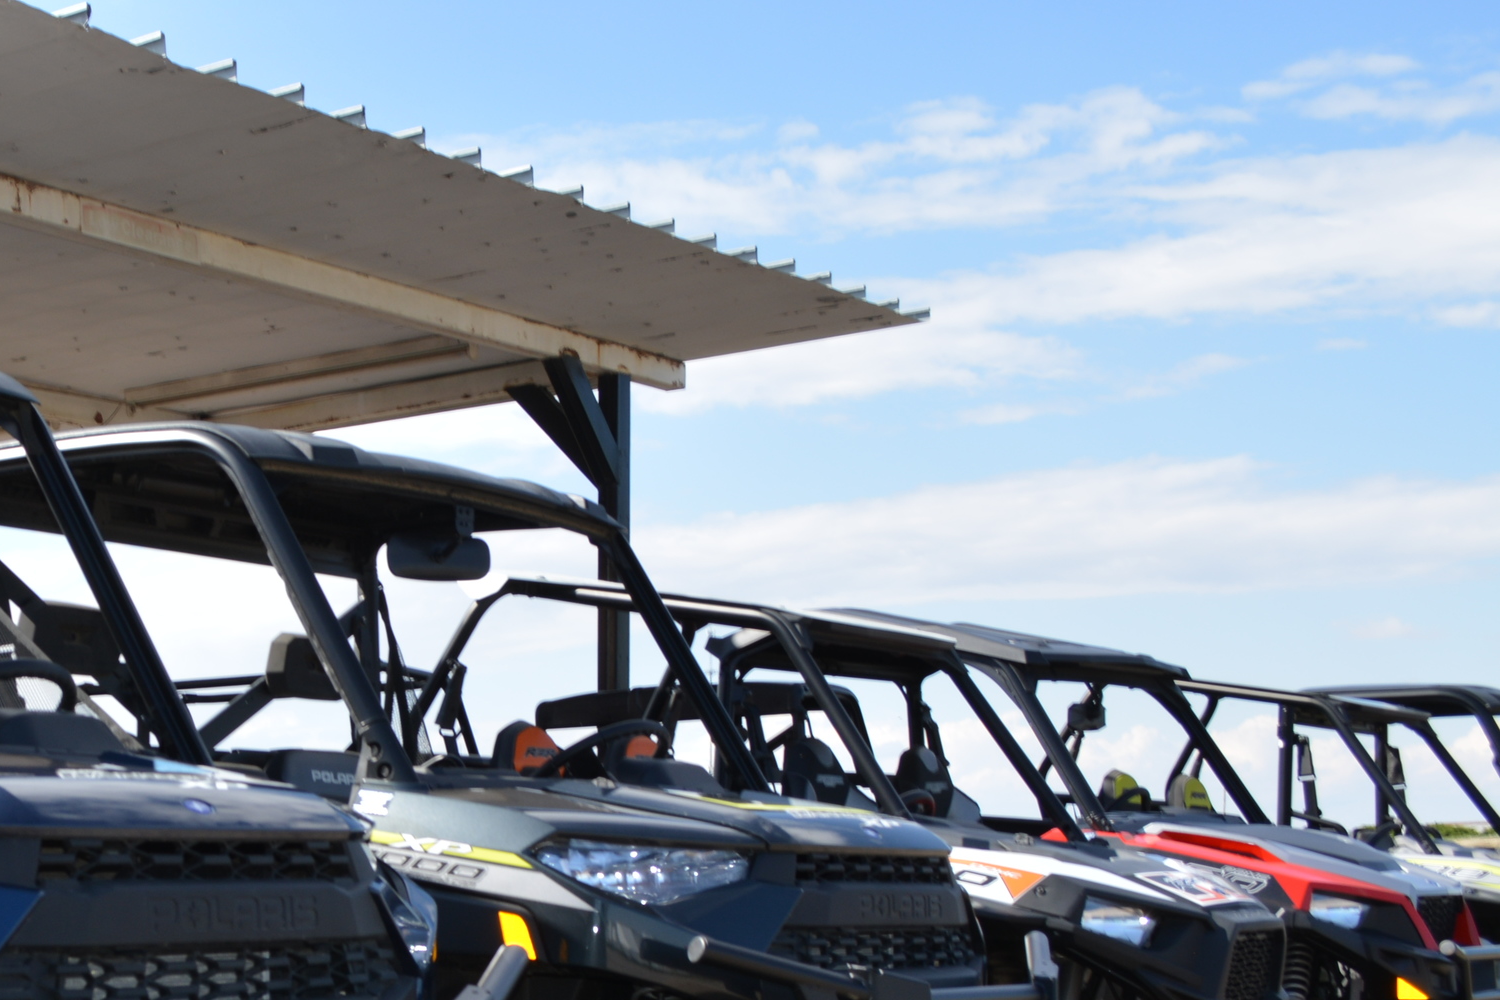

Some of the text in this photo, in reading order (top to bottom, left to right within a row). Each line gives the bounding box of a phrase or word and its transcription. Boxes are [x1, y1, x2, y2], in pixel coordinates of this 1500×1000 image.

[311, 769, 356, 785] POLAR
[389, 833, 473, 855] XP
[371, 847, 490, 882] 000
[149, 895, 320, 932] POLARIS
[860, 893, 943, 919] POLARIS
